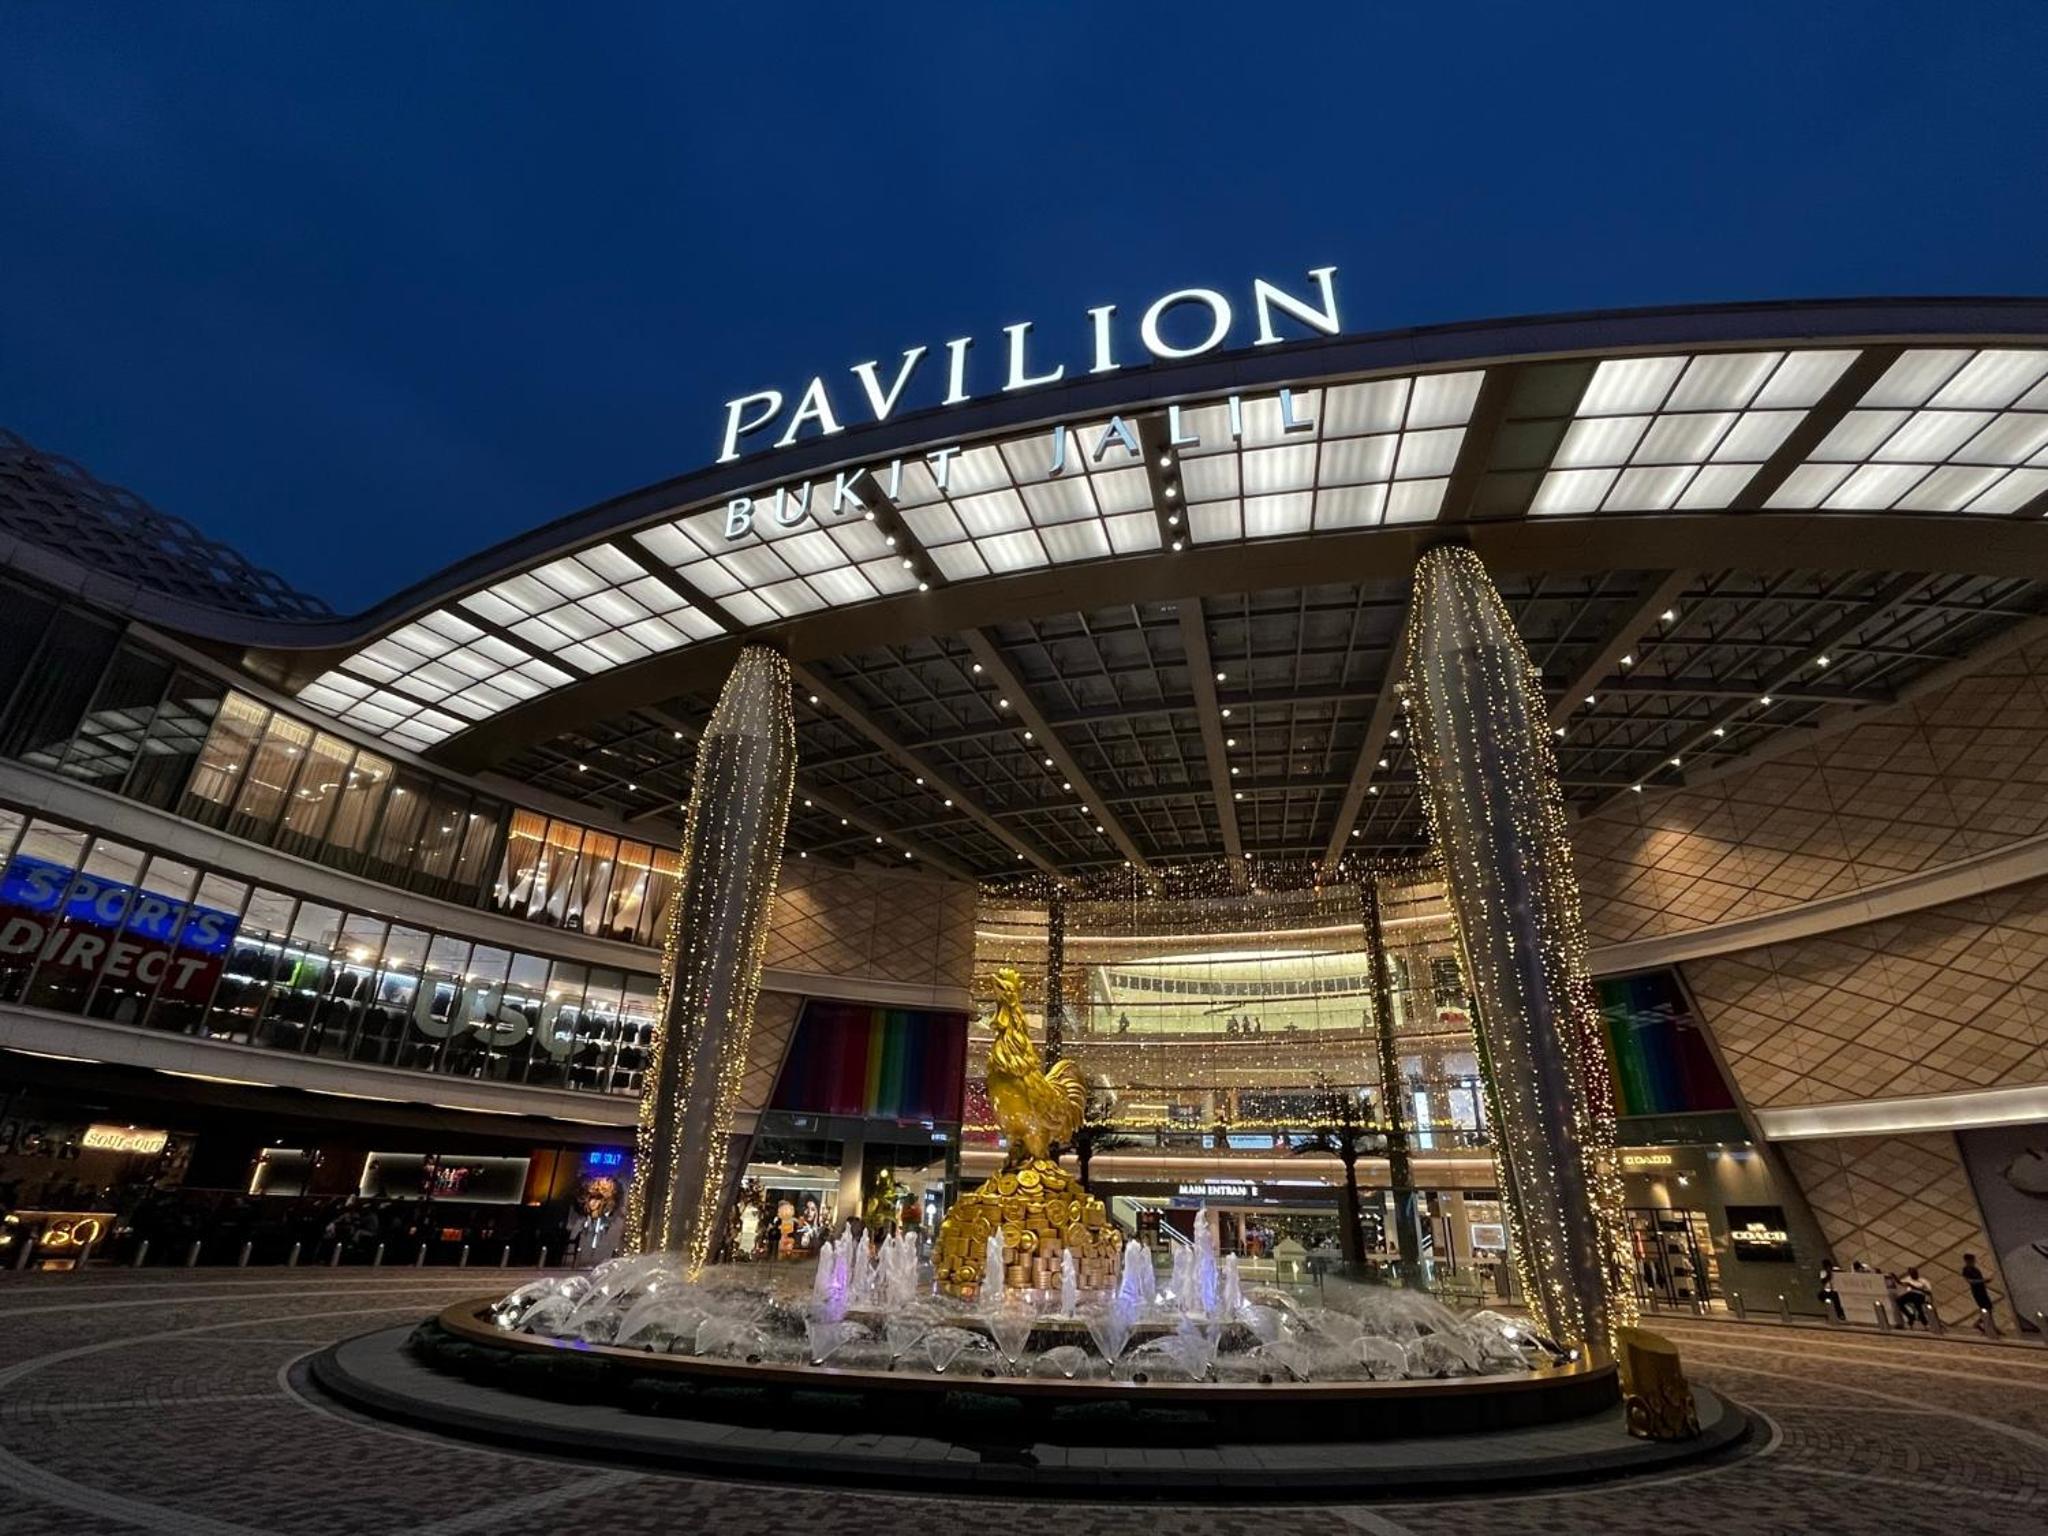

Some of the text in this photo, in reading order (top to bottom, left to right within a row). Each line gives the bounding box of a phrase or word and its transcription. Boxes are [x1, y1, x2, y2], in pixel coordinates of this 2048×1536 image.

[715, 265, 1342, 464] PAVILION
[723, 387, 1316, 541] BUKIT JALIL
[20, 867, 227, 946] SPORTS
[0, 917, 208, 990] DIRECT
[411, 974, 586, 1063] USC
[1179, 1184, 1259, 1197] MAIN ENTRANE
[1731, 1231, 1788, 1241] COACH
